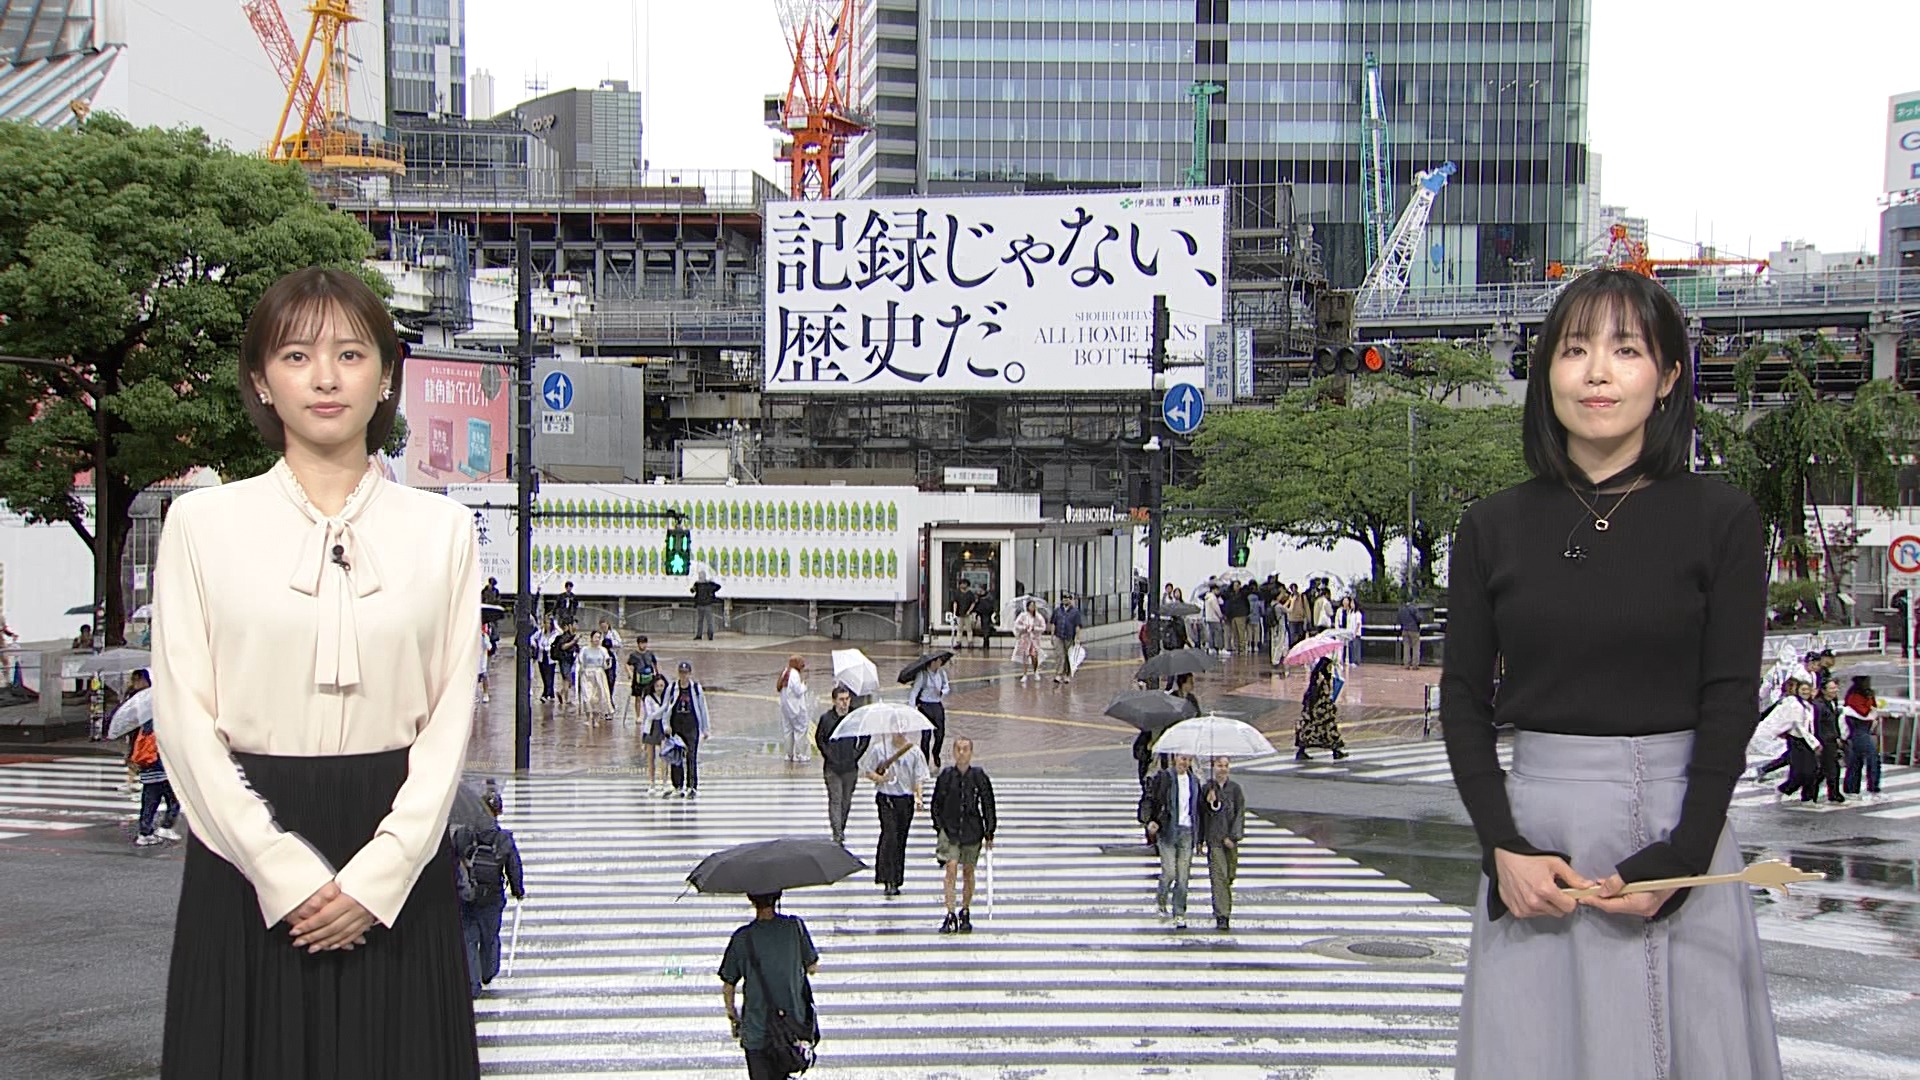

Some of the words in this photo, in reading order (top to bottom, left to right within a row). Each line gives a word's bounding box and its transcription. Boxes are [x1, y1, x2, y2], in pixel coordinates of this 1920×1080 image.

[1194, 195, 1220, 206] MLB
[773, 206, 1218, 294] 記録じゃない、
[1034, 326, 1074, 344] ALL
[1079, 325, 1139, 343] HOME
[1145, 323, 1198, 342] RNS
[1075, 311, 1115, 322] SHOHEI
[1117, 310, 1154, 321] OHTAN
[769, 300, 1026, 384] 歴史だ。
[1216, 331, 1228, 398] 渋谷駅前
